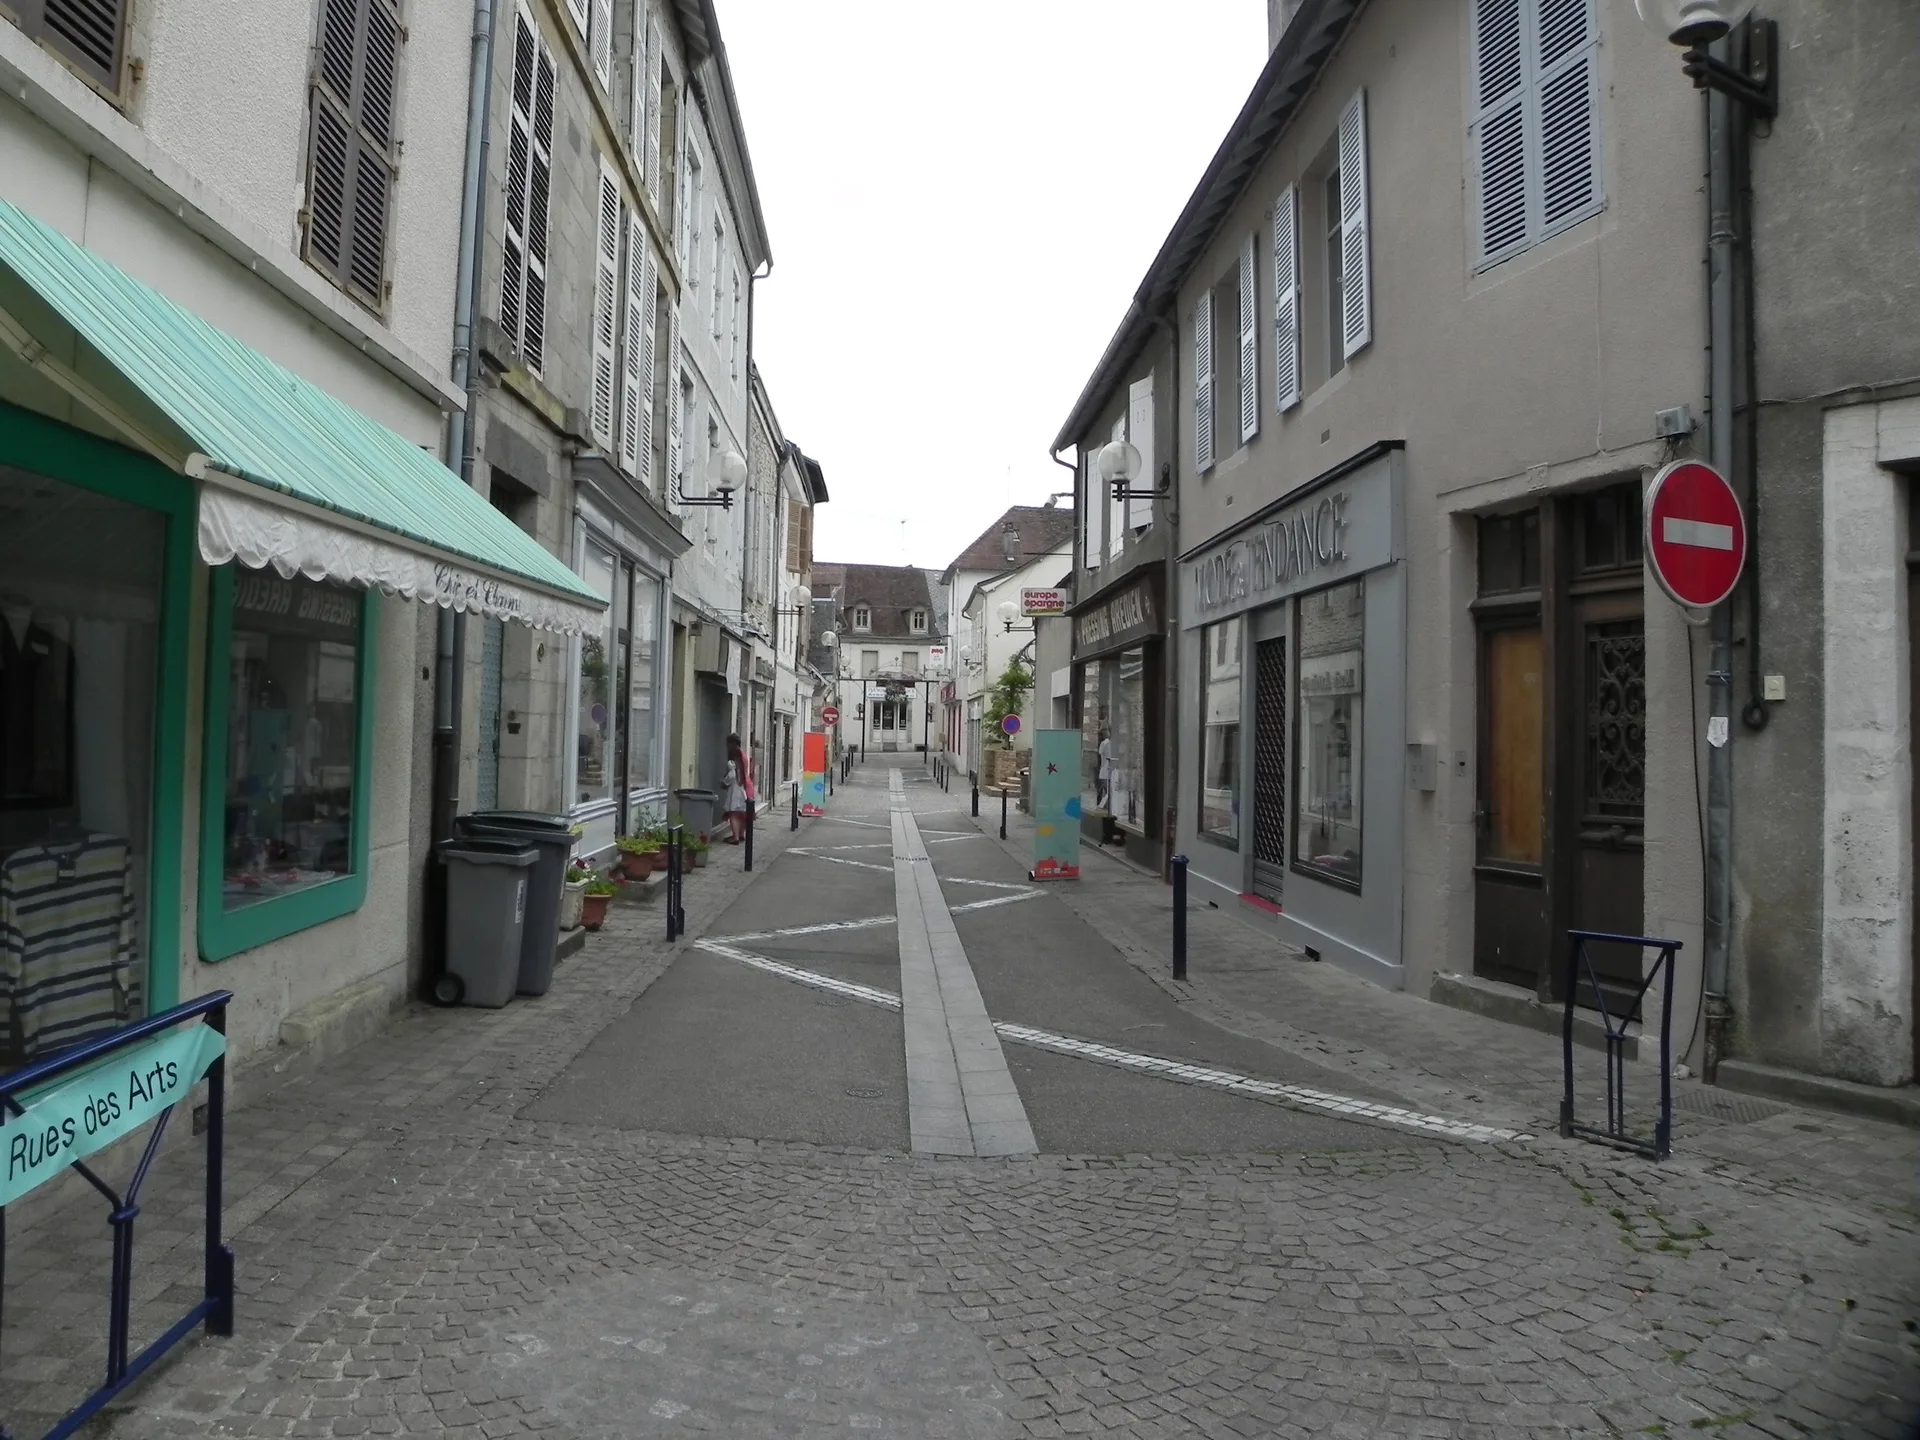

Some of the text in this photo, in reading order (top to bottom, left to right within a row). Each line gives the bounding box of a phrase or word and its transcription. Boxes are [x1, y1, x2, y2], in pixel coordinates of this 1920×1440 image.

[1232, 492, 1348, 592] TENDANCE
[1024, 591, 1058, 600] europe
[9, 1061, 178, 1181] Rues des Arts
